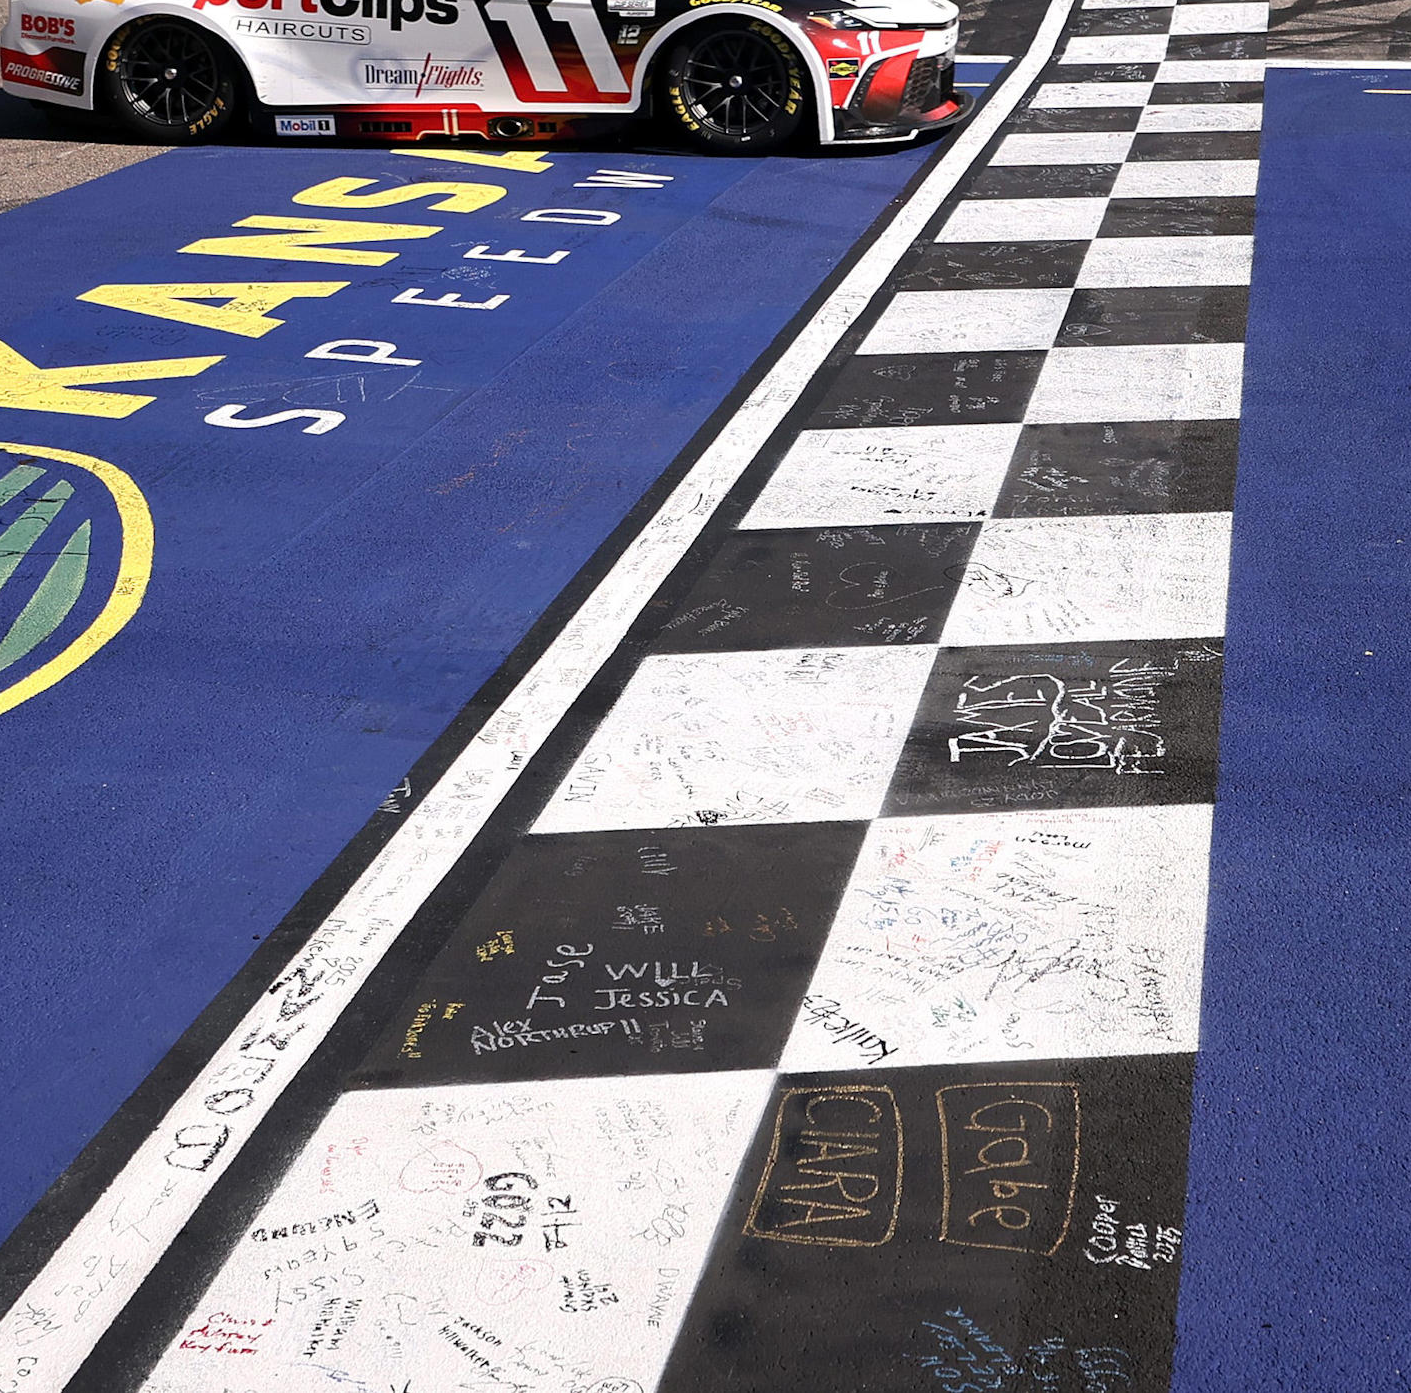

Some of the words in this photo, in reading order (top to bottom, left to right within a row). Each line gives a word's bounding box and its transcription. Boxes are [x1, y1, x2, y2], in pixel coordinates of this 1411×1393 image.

[20, 13, 76, 37] BOB'S
[235, 18, 367, 43] HAIRCUTS
[856, 31, 883, 55] 11
[4, 61, 82, 91] PROGRESSIVE
[365, 63, 418, 87] Dream
[189, 96, 226, 136] EAGLE
[280, 118, 317, 132] Mobil
[668, 85, 701, 132] EAGLE
[563, 752, 612, 806] GAVIN
[774, 1093, 884, 1229] CIARA
[964, 1099, 1054, 1230] Gabe
[646, 1266, 681, 1330] DWAYNE
